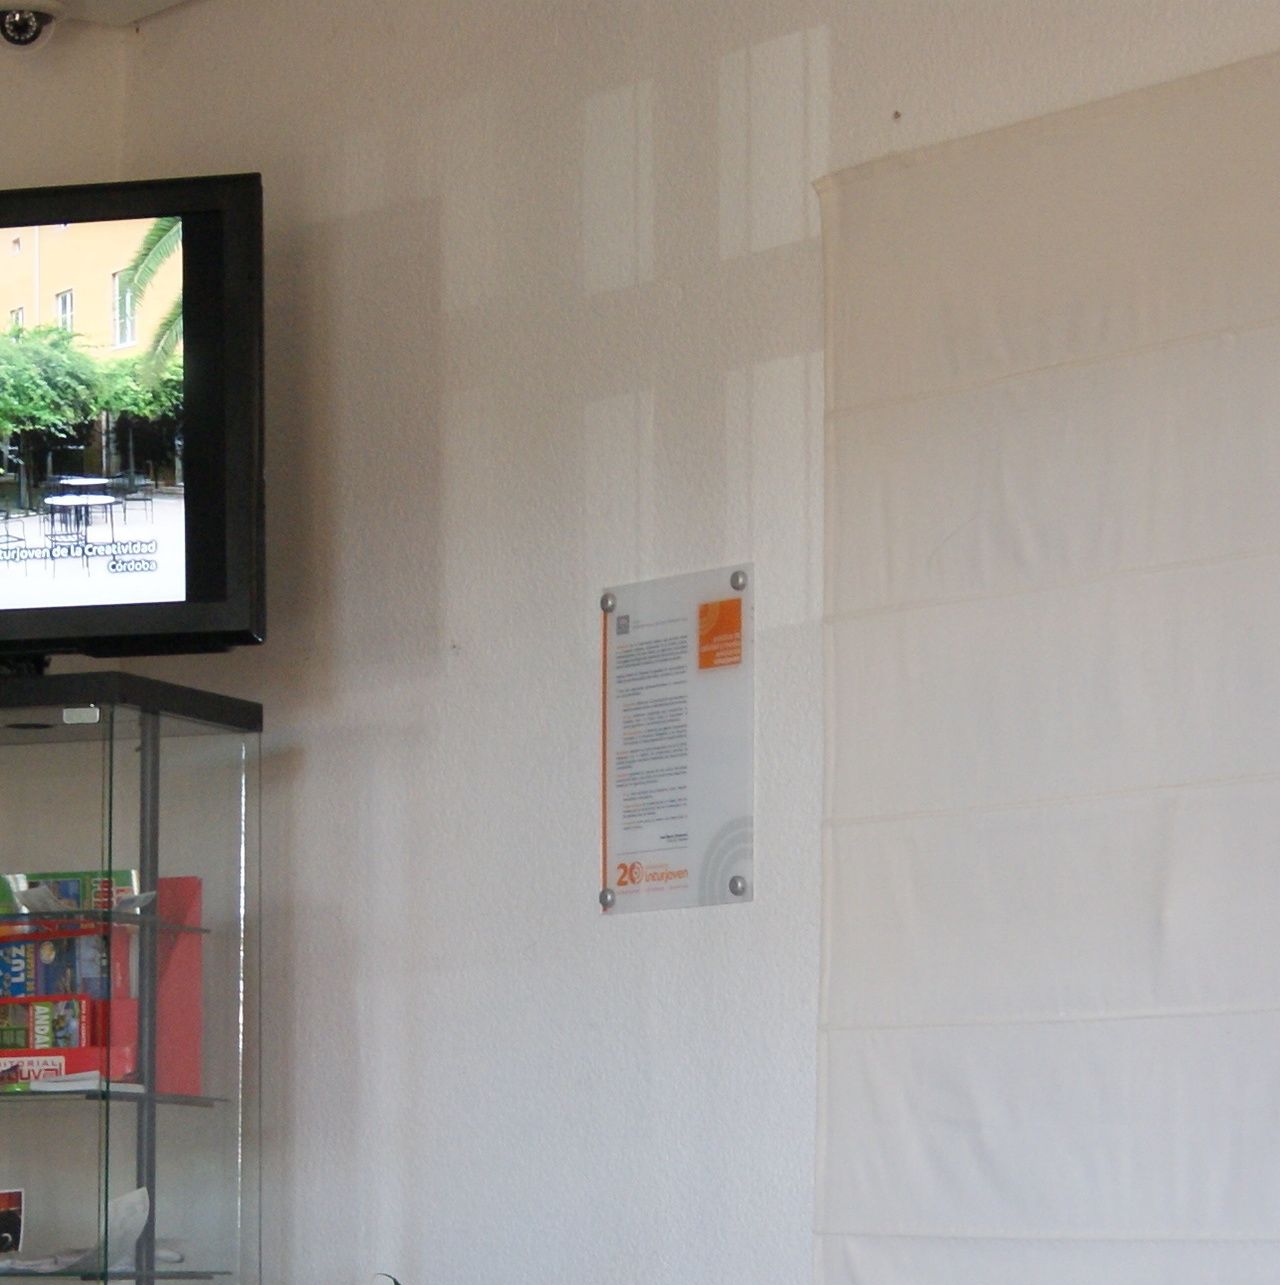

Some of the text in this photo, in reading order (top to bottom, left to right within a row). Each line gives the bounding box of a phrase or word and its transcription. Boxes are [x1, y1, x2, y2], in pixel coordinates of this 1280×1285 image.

[52, 546, 68, 560] de
[70, 546, 81, 559] la
[84, 541, 157, 557] Creatividad
[107, 559, 157, 573] Córdoba
[12, 945, 26, 983] LUZ
